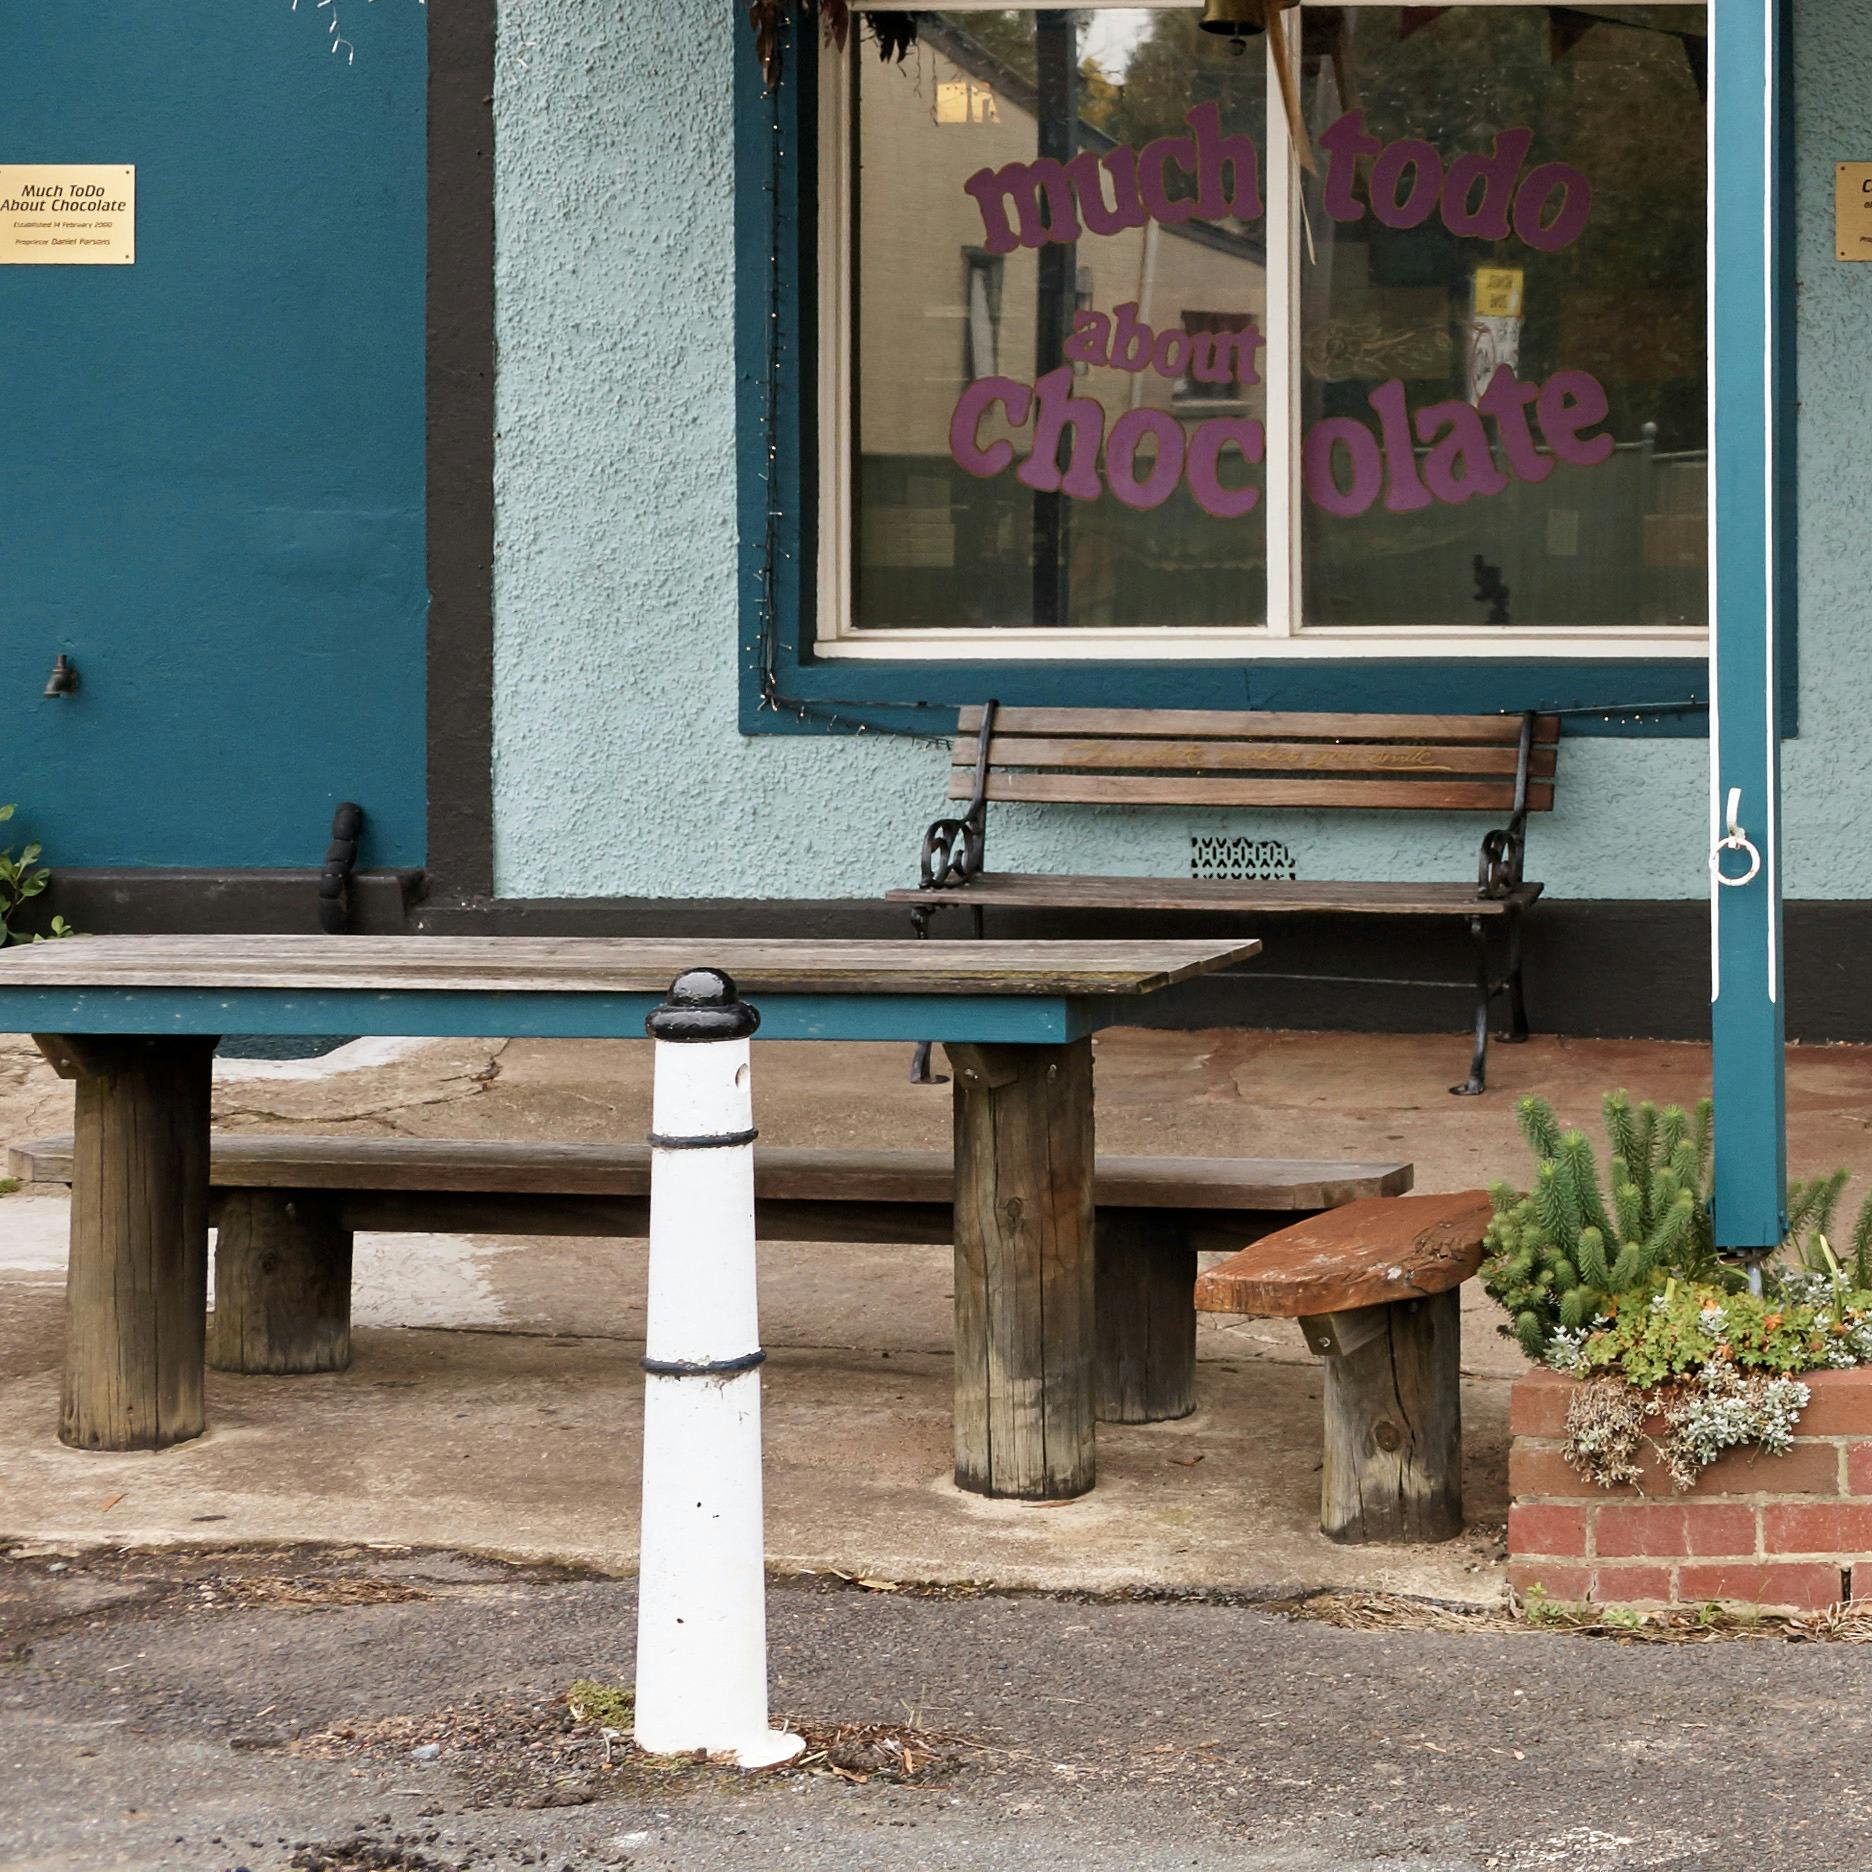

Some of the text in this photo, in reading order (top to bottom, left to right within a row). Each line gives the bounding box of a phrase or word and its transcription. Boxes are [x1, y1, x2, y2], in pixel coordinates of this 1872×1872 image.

[21, 184, 105, 197] Much ToDo
[963, 100, 1264, 255] much
[0, 199, 127, 212] About Chocolate
[1063, 301, 1266, 386] about
